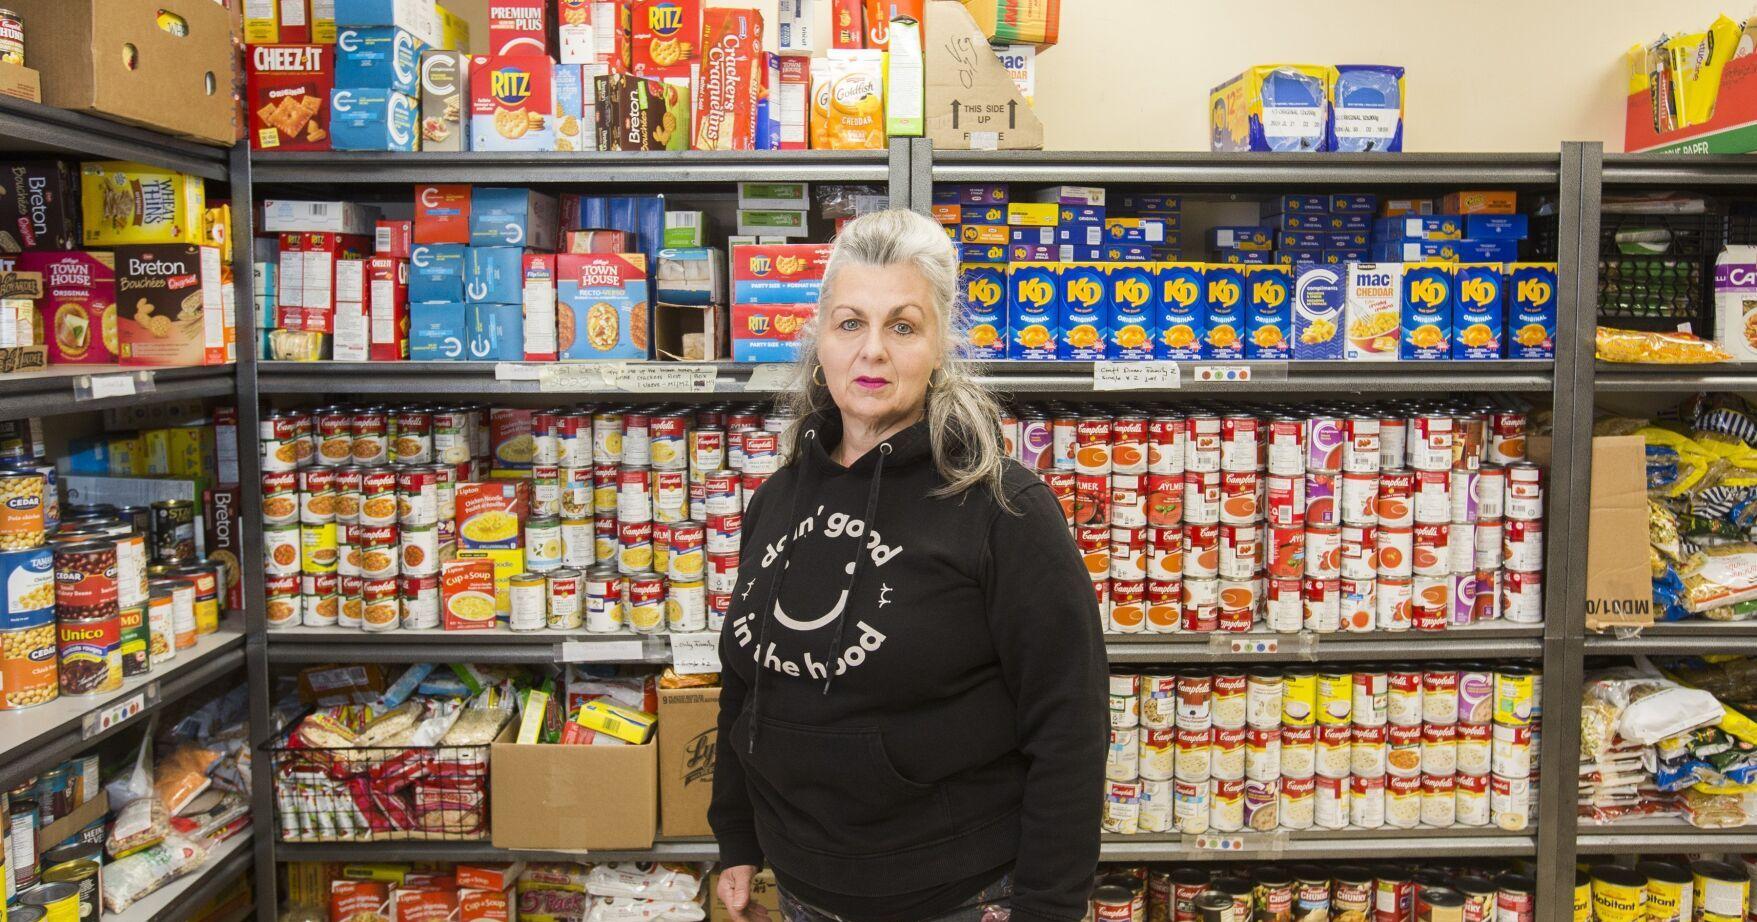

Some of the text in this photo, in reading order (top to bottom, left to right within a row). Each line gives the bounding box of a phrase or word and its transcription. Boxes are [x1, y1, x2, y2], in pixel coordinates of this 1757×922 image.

[490, 7, 542, 19] PREMIUM
[649, 6, 683, 29] RITZ
[515, 18, 542, 31] PLUS
[723, 34, 742, 112] Crackers
[490, 71, 531, 98] RITZ
[836, 82, 875, 102] Goldfish
[707, 45, 725, 140] Craquelins
[964, 104, 1005, 114] THIS SIDE
[628, 90, 640, 144] Breton
[841, 116, 873, 126] CHEDDAR
[977, 116, 992, 125] UP
[28, 176, 48, 236] Breton
[141, 180, 162, 225] THINS
[158, 177, 177, 225] WHEAT
[50, 264, 89, 276] TOWN
[129, 258, 187, 276] Breton
[582, 265, 619, 276] TOWN
[749, 257, 772, 272] RITZ
[50, 275, 92, 287] HOUSE
[582, 275, 620, 286] HOUSE
[1356, 274, 1390, 287] mac
[53, 289, 90, 297] ORIGINAL
[968, 278, 1002, 307] KD
[1018, 277, 1054, 307] KD
[1067, 277, 1102, 307] KD
[1115, 277, 1150, 307] KD
[1164, 277, 1198, 307] KD
[1208, 278, 1240, 307] KD
[1253, 279, 1286, 307] KD
[1356, 288, 1394, 297] CHEDDAR
[1411, 277, 1446, 307] KD
[1461, 277, 1496, 307] KD
[1518, 277, 1551, 307] KD
[748, 316, 770, 331] RITZ
[1020, 314, 1050, 323] ORIGINAL
[1069, 314, 1099, 323] ORIGINAL
[1117, 314, 1147, 323] ORIGINAL
[1165, 314, 1195, 323] ORIGINAL
[1210, 314, 1237, 323] ORIGINAL
[1254, 314, 1283, 323] ORIGINAL
[1412, 314, 1443, 323] ORIGINAL
[1463, 314, 1493, 323] ORIGINAL
[1519, 314, 1548, 323] ORIGINAL
[459, 487, 479, 495] Lipton
[9, 498, 39, 507] CEDAR
[214, 493, 232, 548] Breton
[824, 512, 903, 567] good
[56, 573, 81, 581] CEDAR
[446, 571, 491, 586] Cup Soup
[61, 629, 104, 641] Unico
[733, 612, 887, 680] in the hood
[485, 899, 506, 908] Soup
[1591, 893, 1636, 911] Habitant
